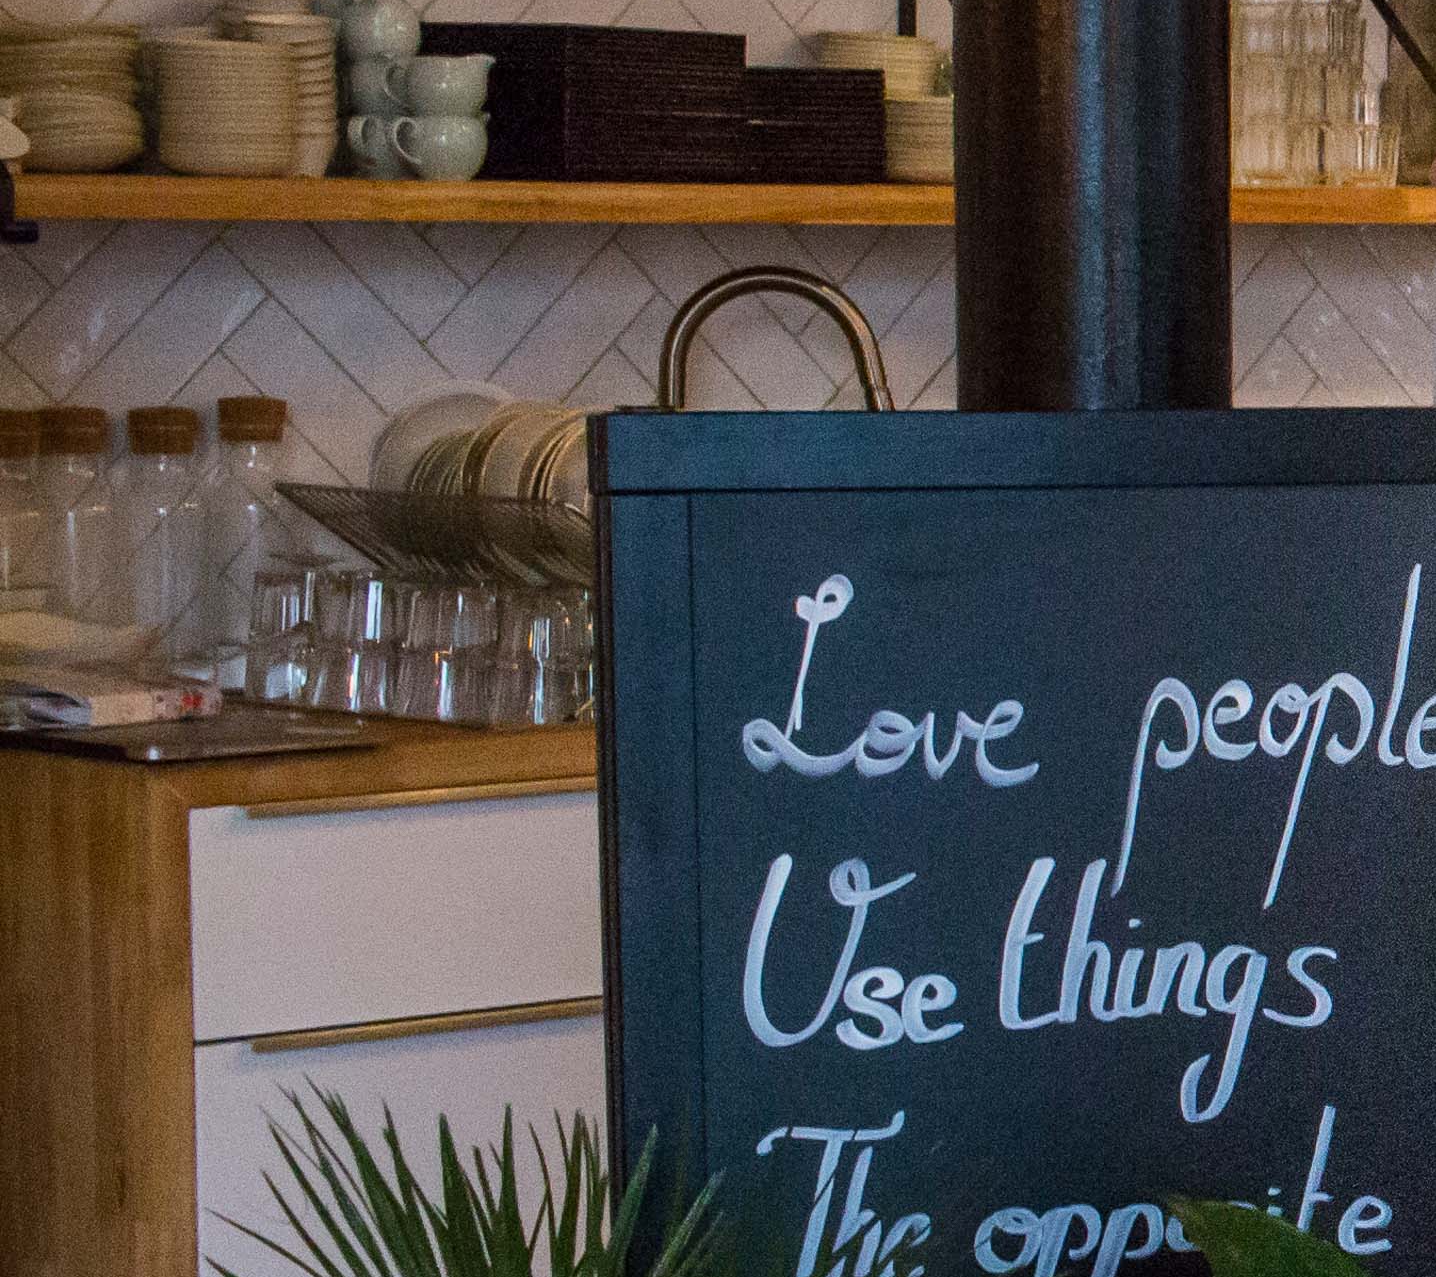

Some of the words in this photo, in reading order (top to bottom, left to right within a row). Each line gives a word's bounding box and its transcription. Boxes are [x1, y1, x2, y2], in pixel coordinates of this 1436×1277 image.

[741, 573, 1040, 790] Love
[742, 853, 965, 1051] Use
[999, 855, 1339, 1124] things
